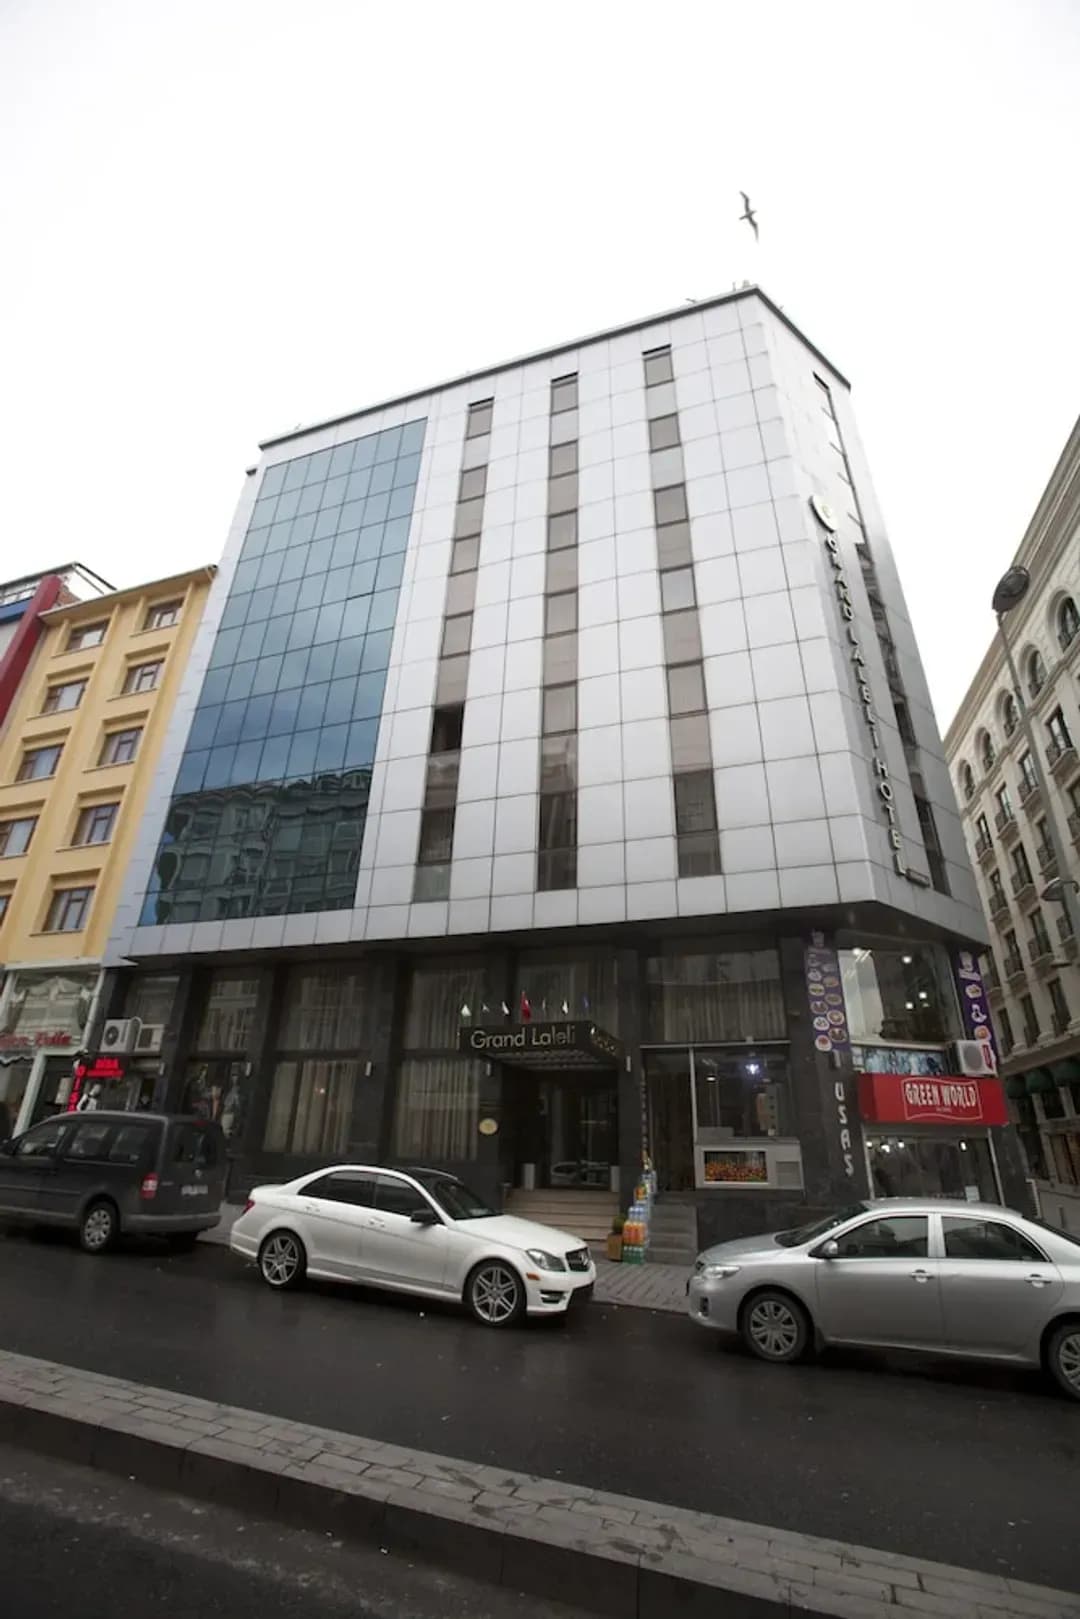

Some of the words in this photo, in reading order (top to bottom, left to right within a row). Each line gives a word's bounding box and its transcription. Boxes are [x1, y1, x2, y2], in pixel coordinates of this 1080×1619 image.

[872, 756, 906, 876] HOTEL
[470, 1026, 526, 1049] Grand
[531, 1023, 576, 1046] Laleli
[905, 1082, 941, 1107] GREEN
[941, 1085, 977, 1109] WORLD
